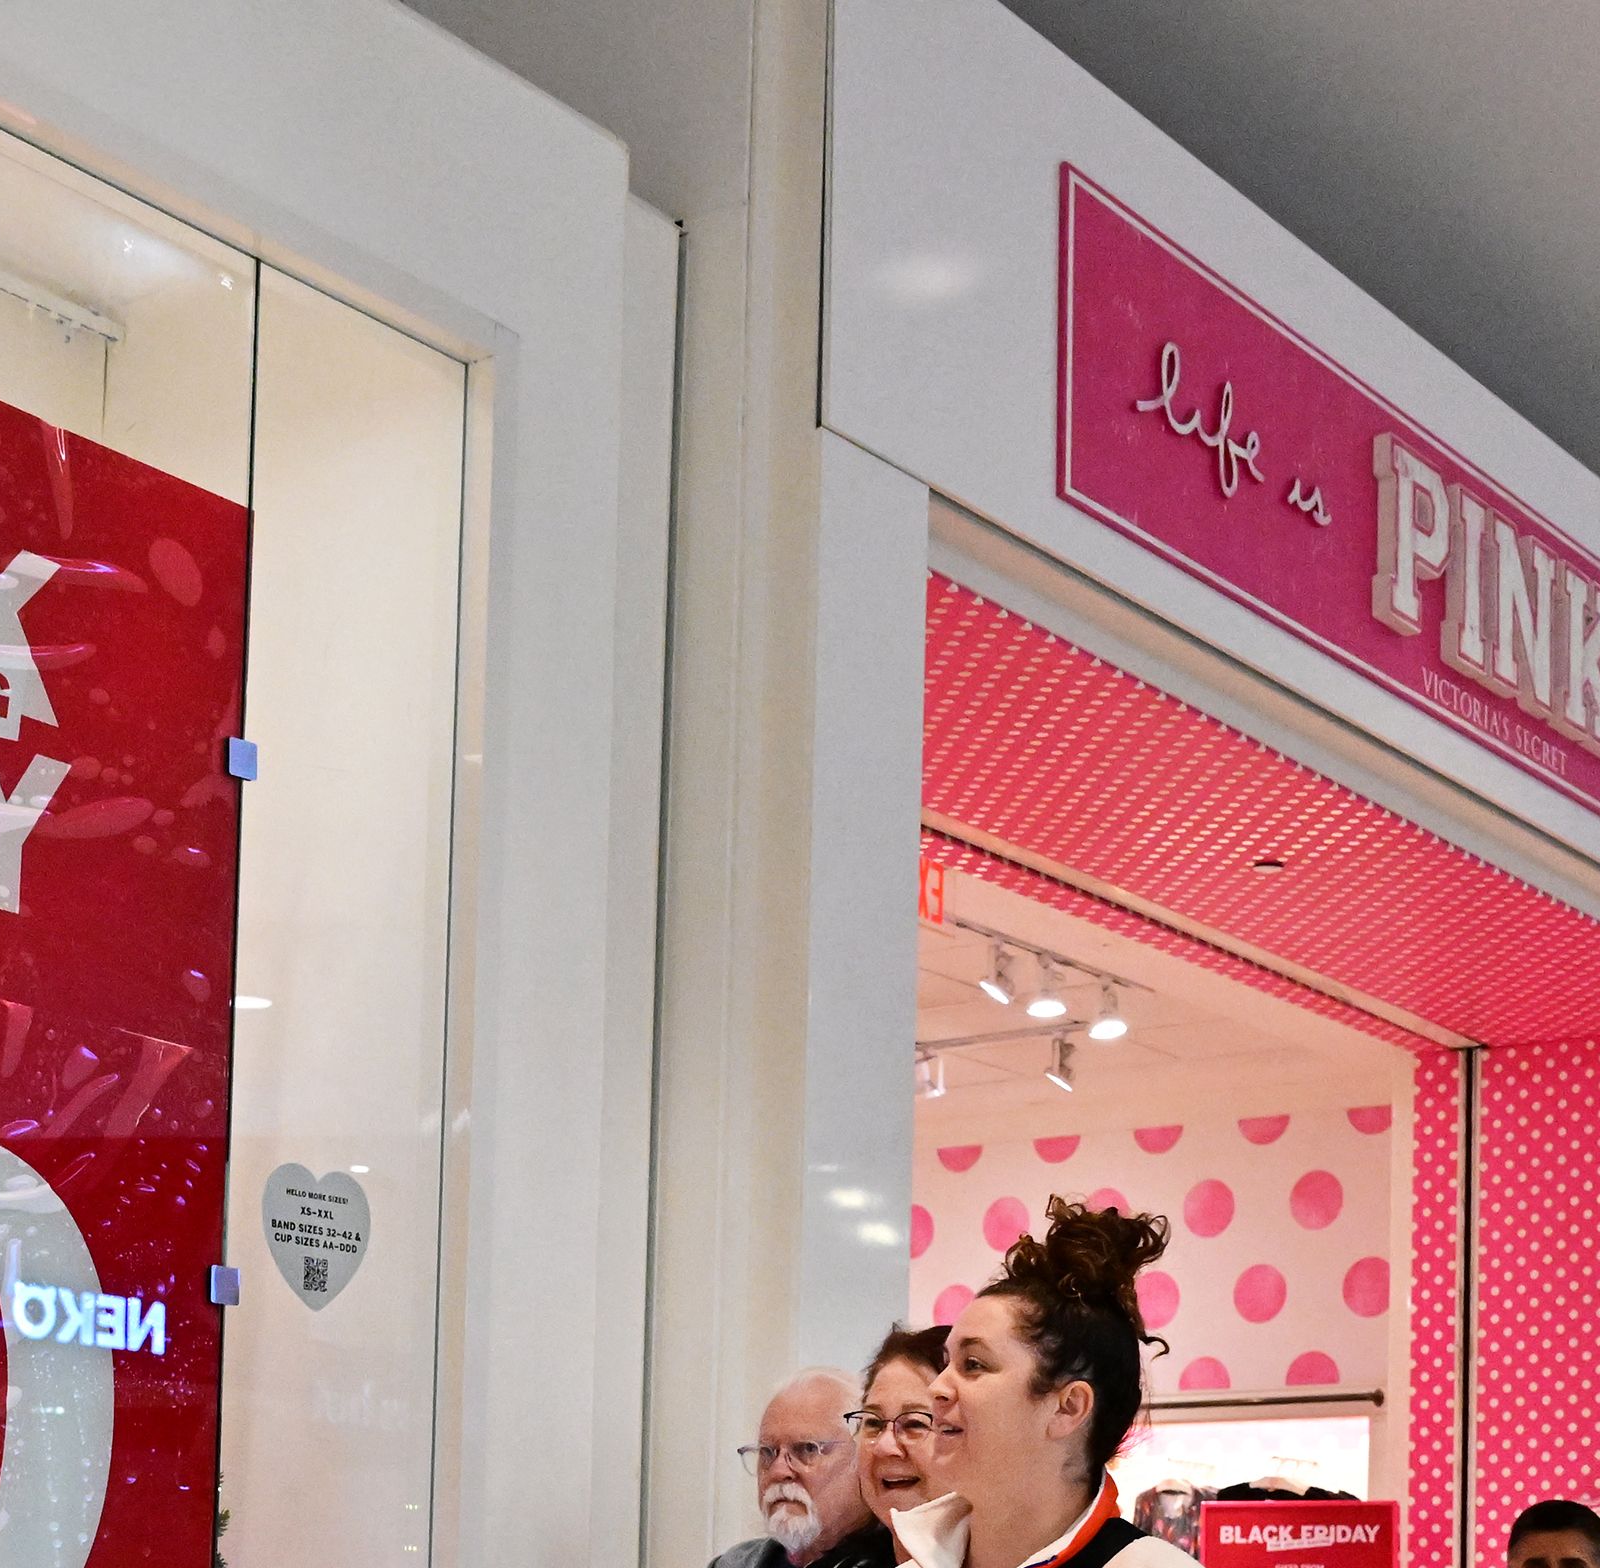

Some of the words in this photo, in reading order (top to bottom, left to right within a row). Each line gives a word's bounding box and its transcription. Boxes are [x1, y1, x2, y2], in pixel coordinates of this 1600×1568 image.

[1136, 341, 1266, 497] life
[1286, 477, 1333, 527] is
[1422, 666, 1509, 741] VICTORIA'S
[1515, 725, 1567, 775] SECRET
[286, 1188, 307, 1198] HELLO
[308, 1192, 326, 1202] MORE
[300, 1206, 334, 1220] XS-XXL
[271, 1218, 296, 1231] BAND
[298, 1223, 323, 1236] SIZES
[326, 1228, 353, 1241] 32-42
[354, 1231, 361, 1242] &
[274, 1232, 292, 1244] CUP
[295, 1235, 320, 1248] SIZES
[322, 1240, 358, 1254] AA-DDD
[1219, 1525, 1294, 1545] BLACK
[1300, 1524, 1381, 1545] FRIDAY
